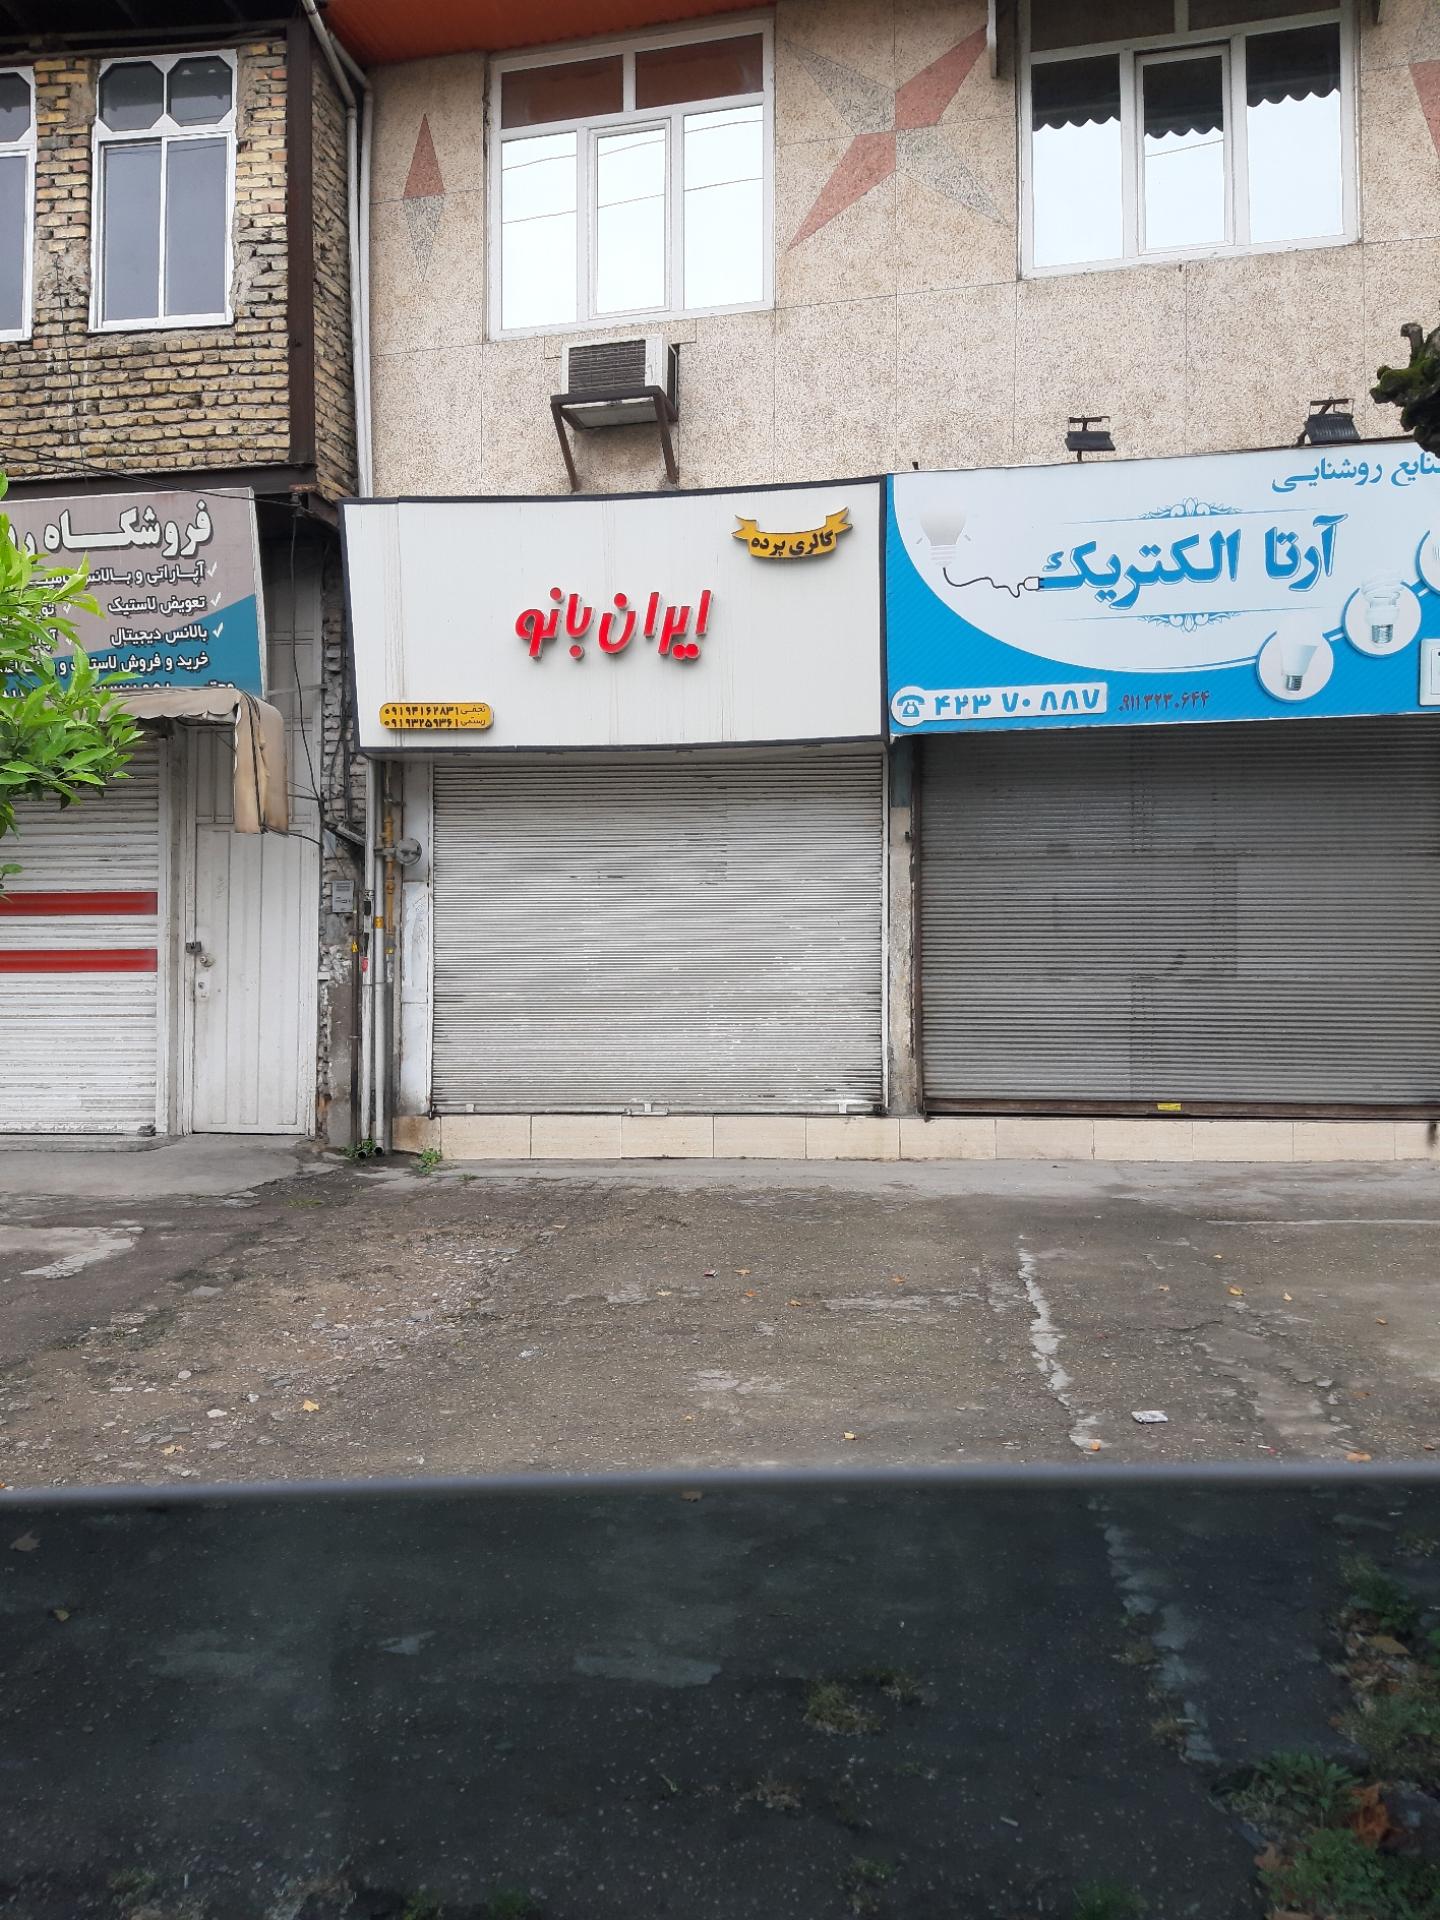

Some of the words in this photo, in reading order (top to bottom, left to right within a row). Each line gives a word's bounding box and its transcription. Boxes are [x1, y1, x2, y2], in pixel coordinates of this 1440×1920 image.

[1271, 457, 1383, 493] روشنایی
[1391, 452, 1440, 487] نایع
[750, 537, 786, 557] پرده
[1264, 513, 1348, 593] آرتا
[134, 570, 144, 586] و
[108, 596, 157, 617] لاستیک
[160, 595, 207, 616] تعویض
[514, 586, 595, 660] بانو
[598, 589, 713, 660] ایران
[110, 626, 162, 647] دیجیتال
[165, 623, 208, 646] بالانس
[121, 652, 161, 673] فروش
[165, 656, 173, 672] و
[176, 651, 209, 671] خرید
